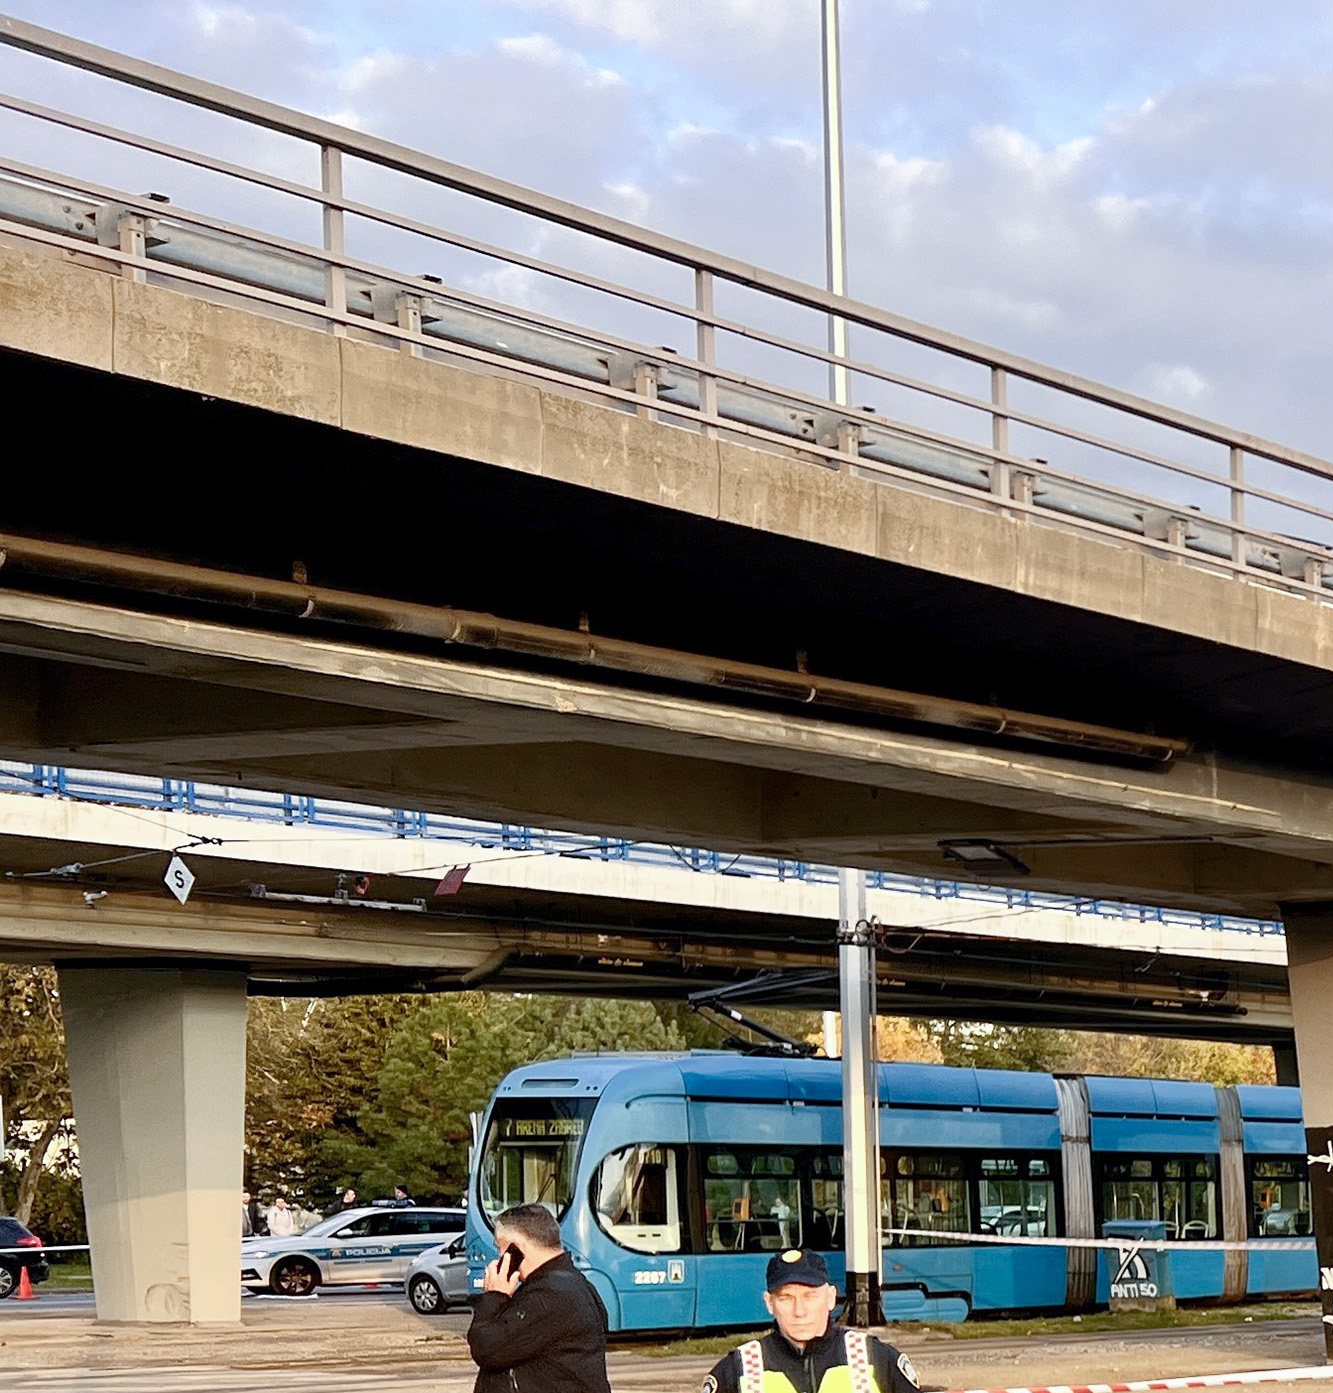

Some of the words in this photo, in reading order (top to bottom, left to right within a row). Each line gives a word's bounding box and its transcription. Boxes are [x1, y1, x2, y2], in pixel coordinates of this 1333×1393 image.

[174, 869, 185, 889] S
[504, 1118, 513, 1137] 7
[516, 1120, 547, 1136] ARENA
[345, 1247, 392, 1256] POLICIJA
[1110, 1283, 1138, 1298] ANTI
